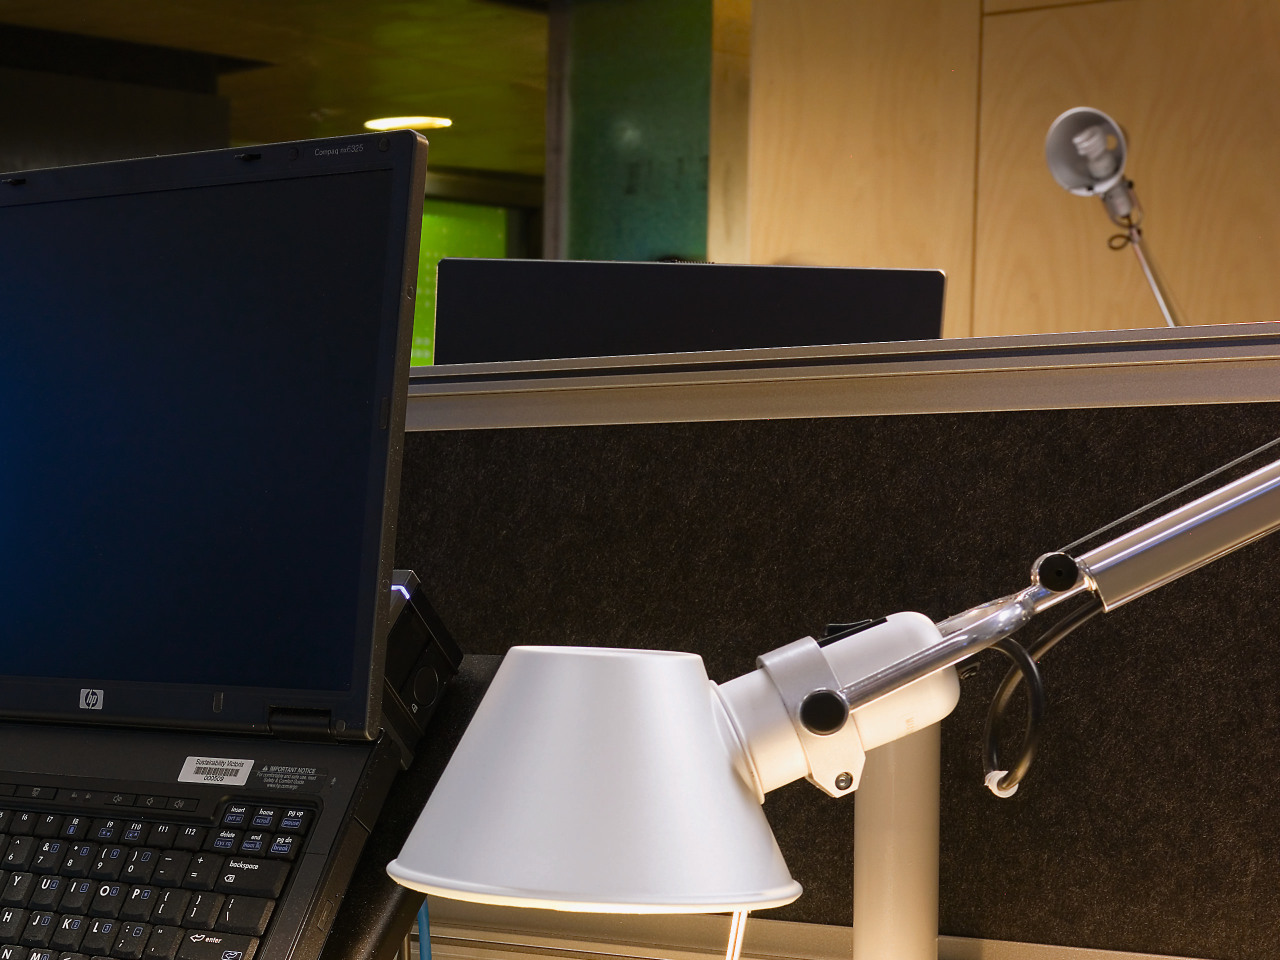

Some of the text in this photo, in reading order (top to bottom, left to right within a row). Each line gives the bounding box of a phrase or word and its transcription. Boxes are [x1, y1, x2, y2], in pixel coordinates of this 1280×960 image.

[314, 148, 338, 156] Compaq
[196, 758, 244, 768] Sustainability Victoria
[220, 830, 236, 838] delete
[230, 860, 258, 870] backspace
[14, 876, 22, 886] Y
[42, 879, 50, 890] U
[70, 882, 76, 892] I
[100, 886, 110, 896] O
[132, 888, 140, 900] P
[2, 912, 12, 922] H
[32, 916, 40, 926] J
[62, 918, 72, 930] K
[92, 922, 99, 932] L
[205, 936, 222, 944] enter
[2, 948, 12, 960] N
